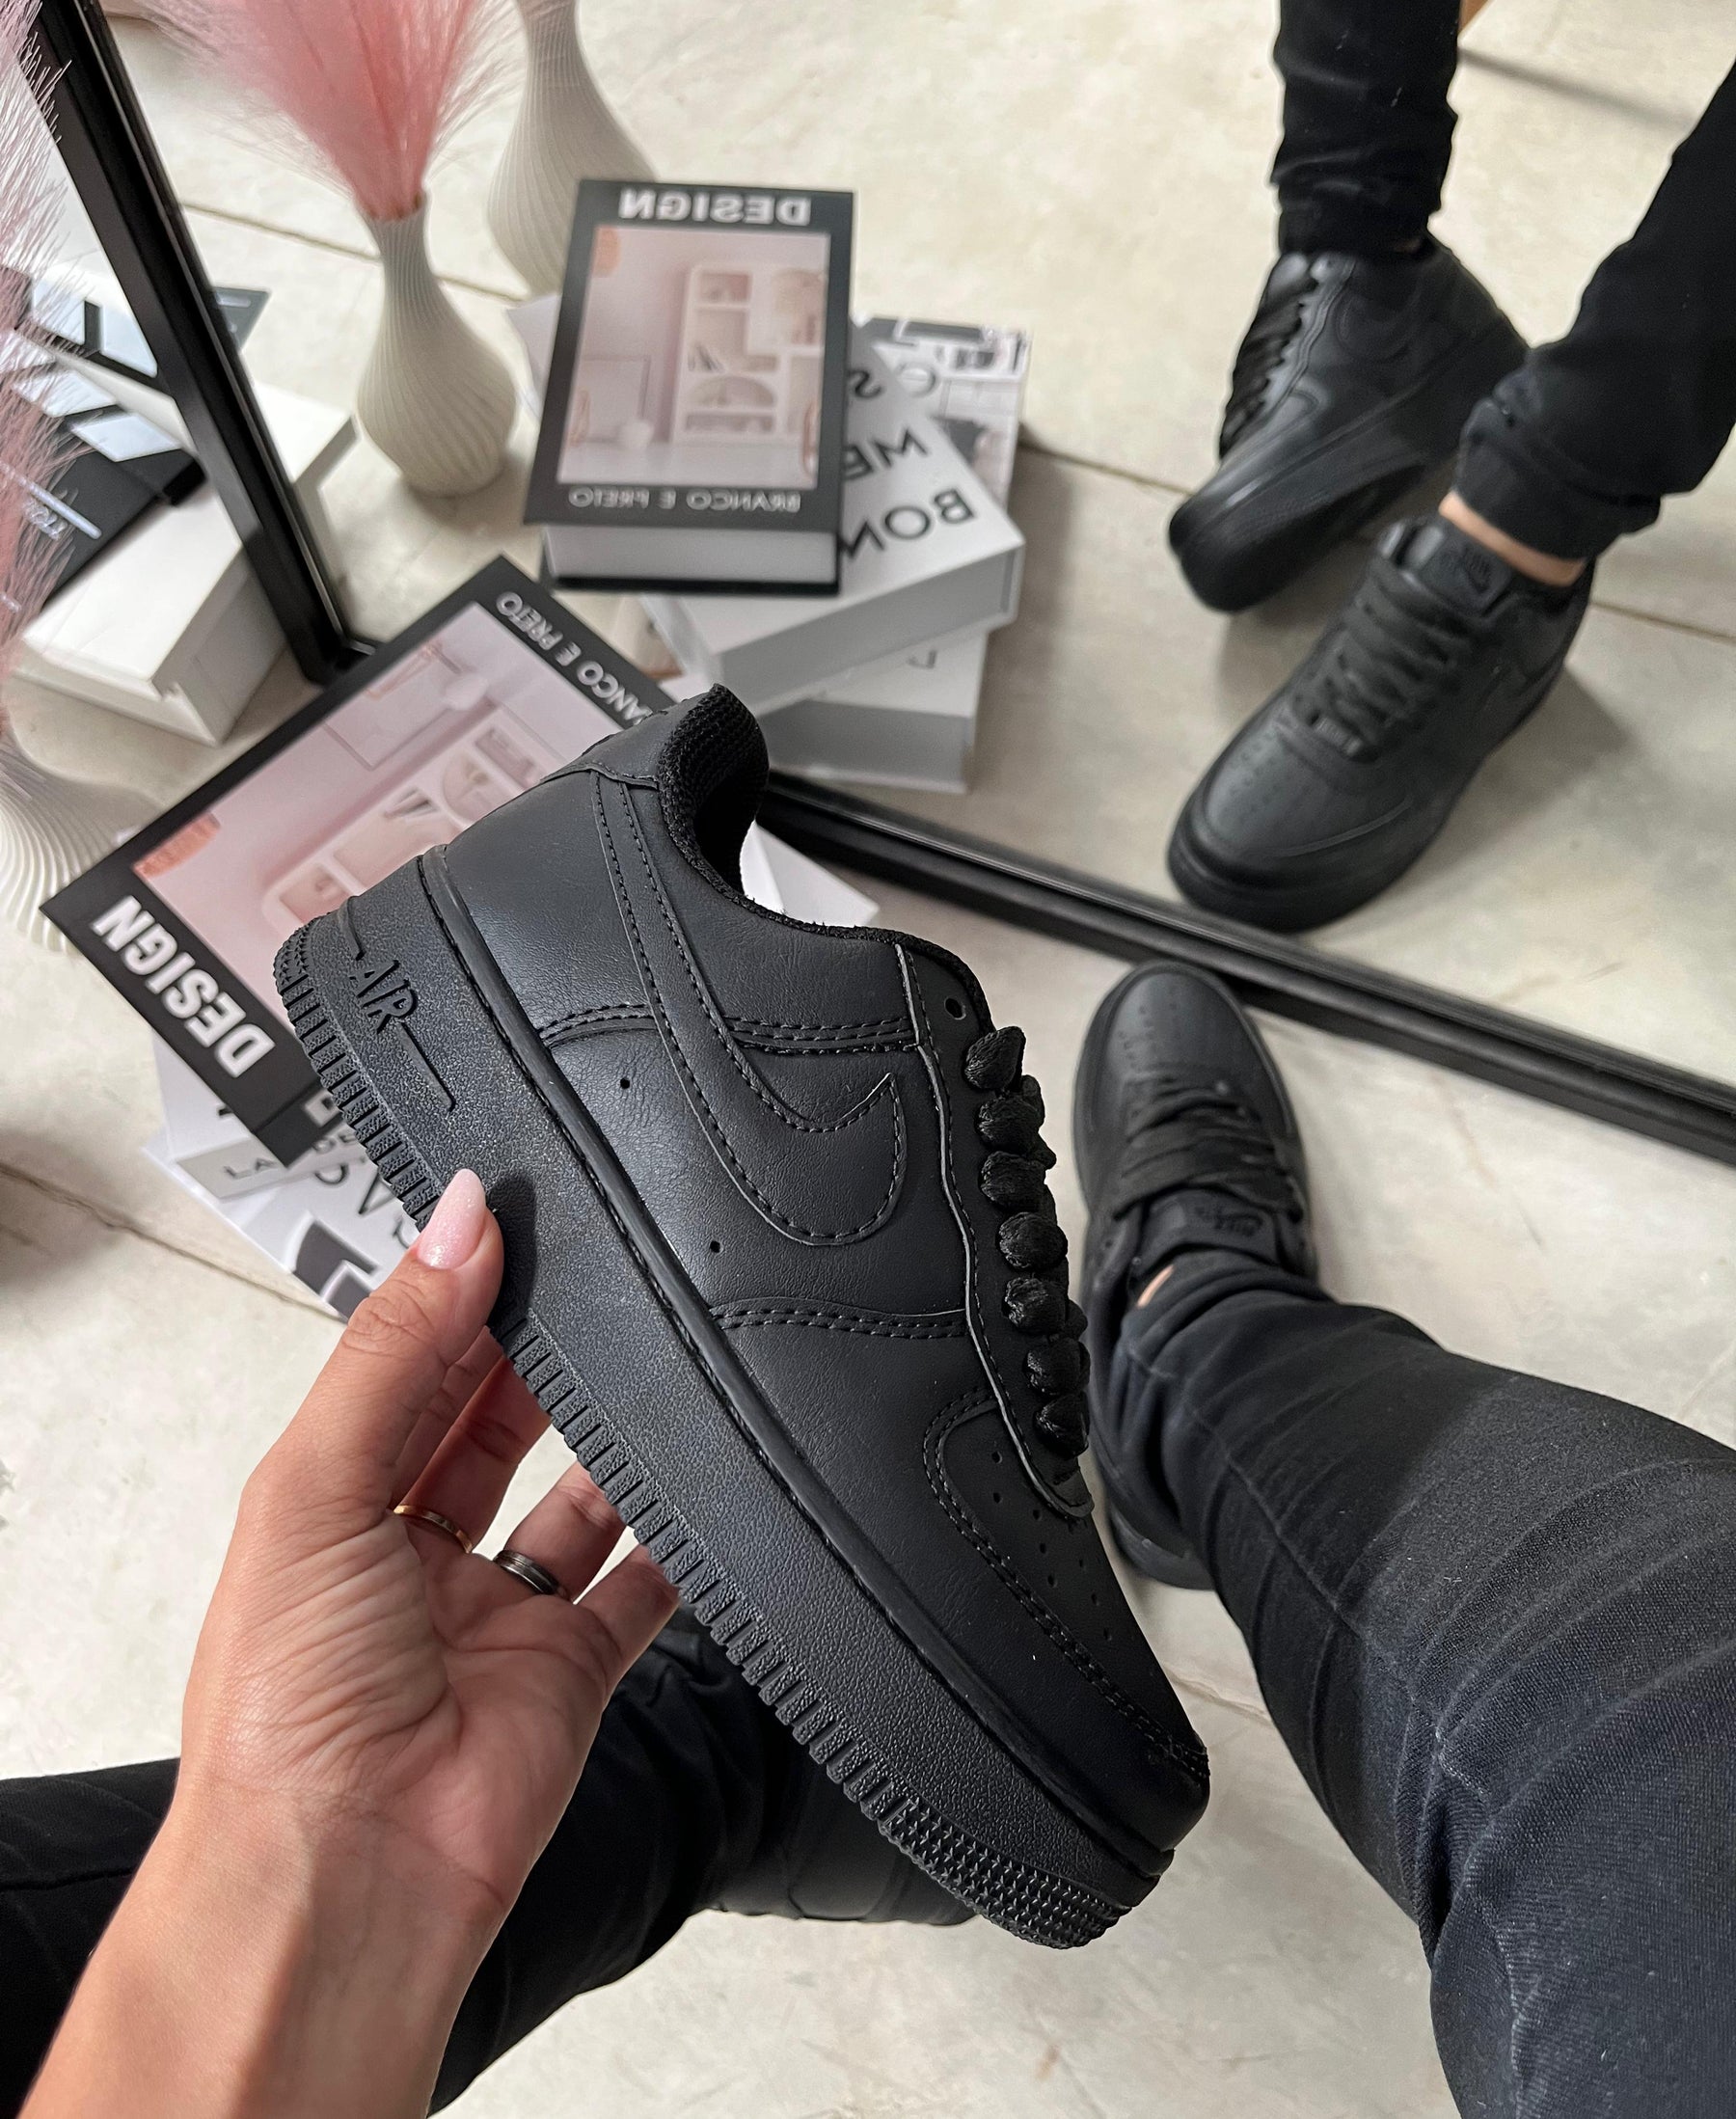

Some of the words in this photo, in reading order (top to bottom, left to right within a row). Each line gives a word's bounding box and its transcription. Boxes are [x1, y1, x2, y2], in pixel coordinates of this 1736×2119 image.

[496, 591, 564, 651] PRETO
[577, 661, 653, 725] ANCO
[91, 895, 276, 1078] DESIGN
[348, 960, 419, 1035] AIR
